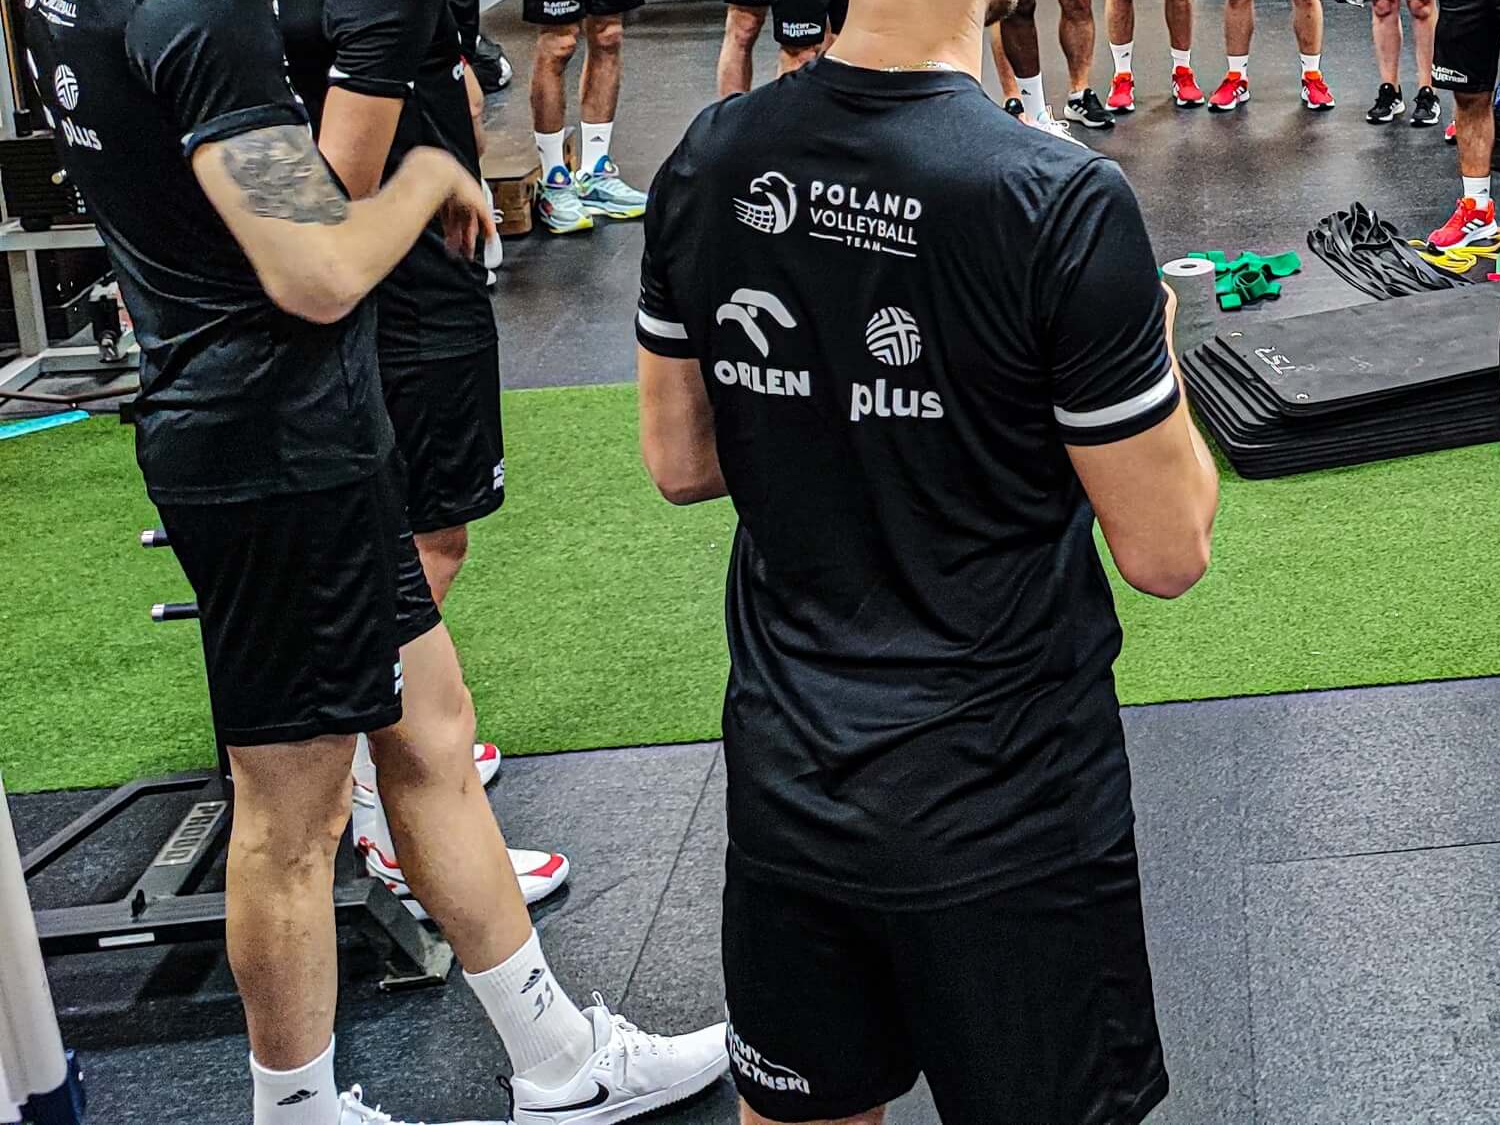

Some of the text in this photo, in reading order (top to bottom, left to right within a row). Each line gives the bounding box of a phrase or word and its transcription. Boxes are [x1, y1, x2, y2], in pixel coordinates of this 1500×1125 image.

[809, 180, 922, 220] POLAND
[809, 207, 918, 245] VOLLEYBALL
[846, 235, 881, 252] TEAM
[713, 359, 811, 397] ORLEN
[850, 378, 944, 422] plus
